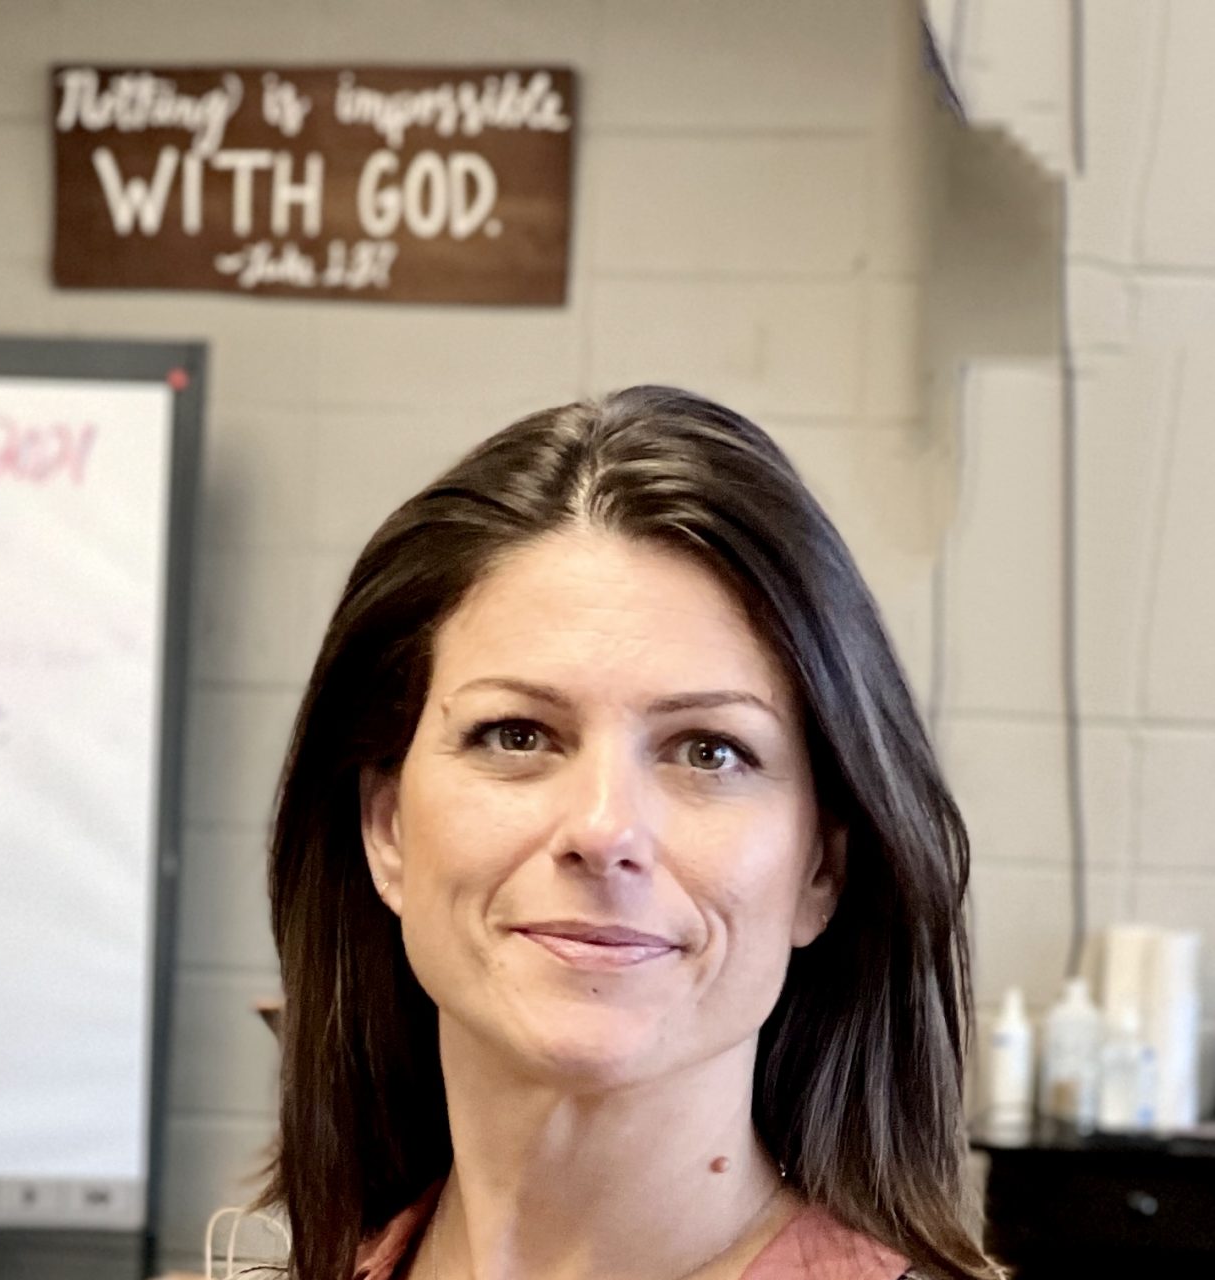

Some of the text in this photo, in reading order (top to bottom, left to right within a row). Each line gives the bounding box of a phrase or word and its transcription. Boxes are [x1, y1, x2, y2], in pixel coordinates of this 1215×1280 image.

[262, 70, 312, 137] is
[334, 70, 571, 149] impossible
[92, 145, 503, 240] WITH GOD.
